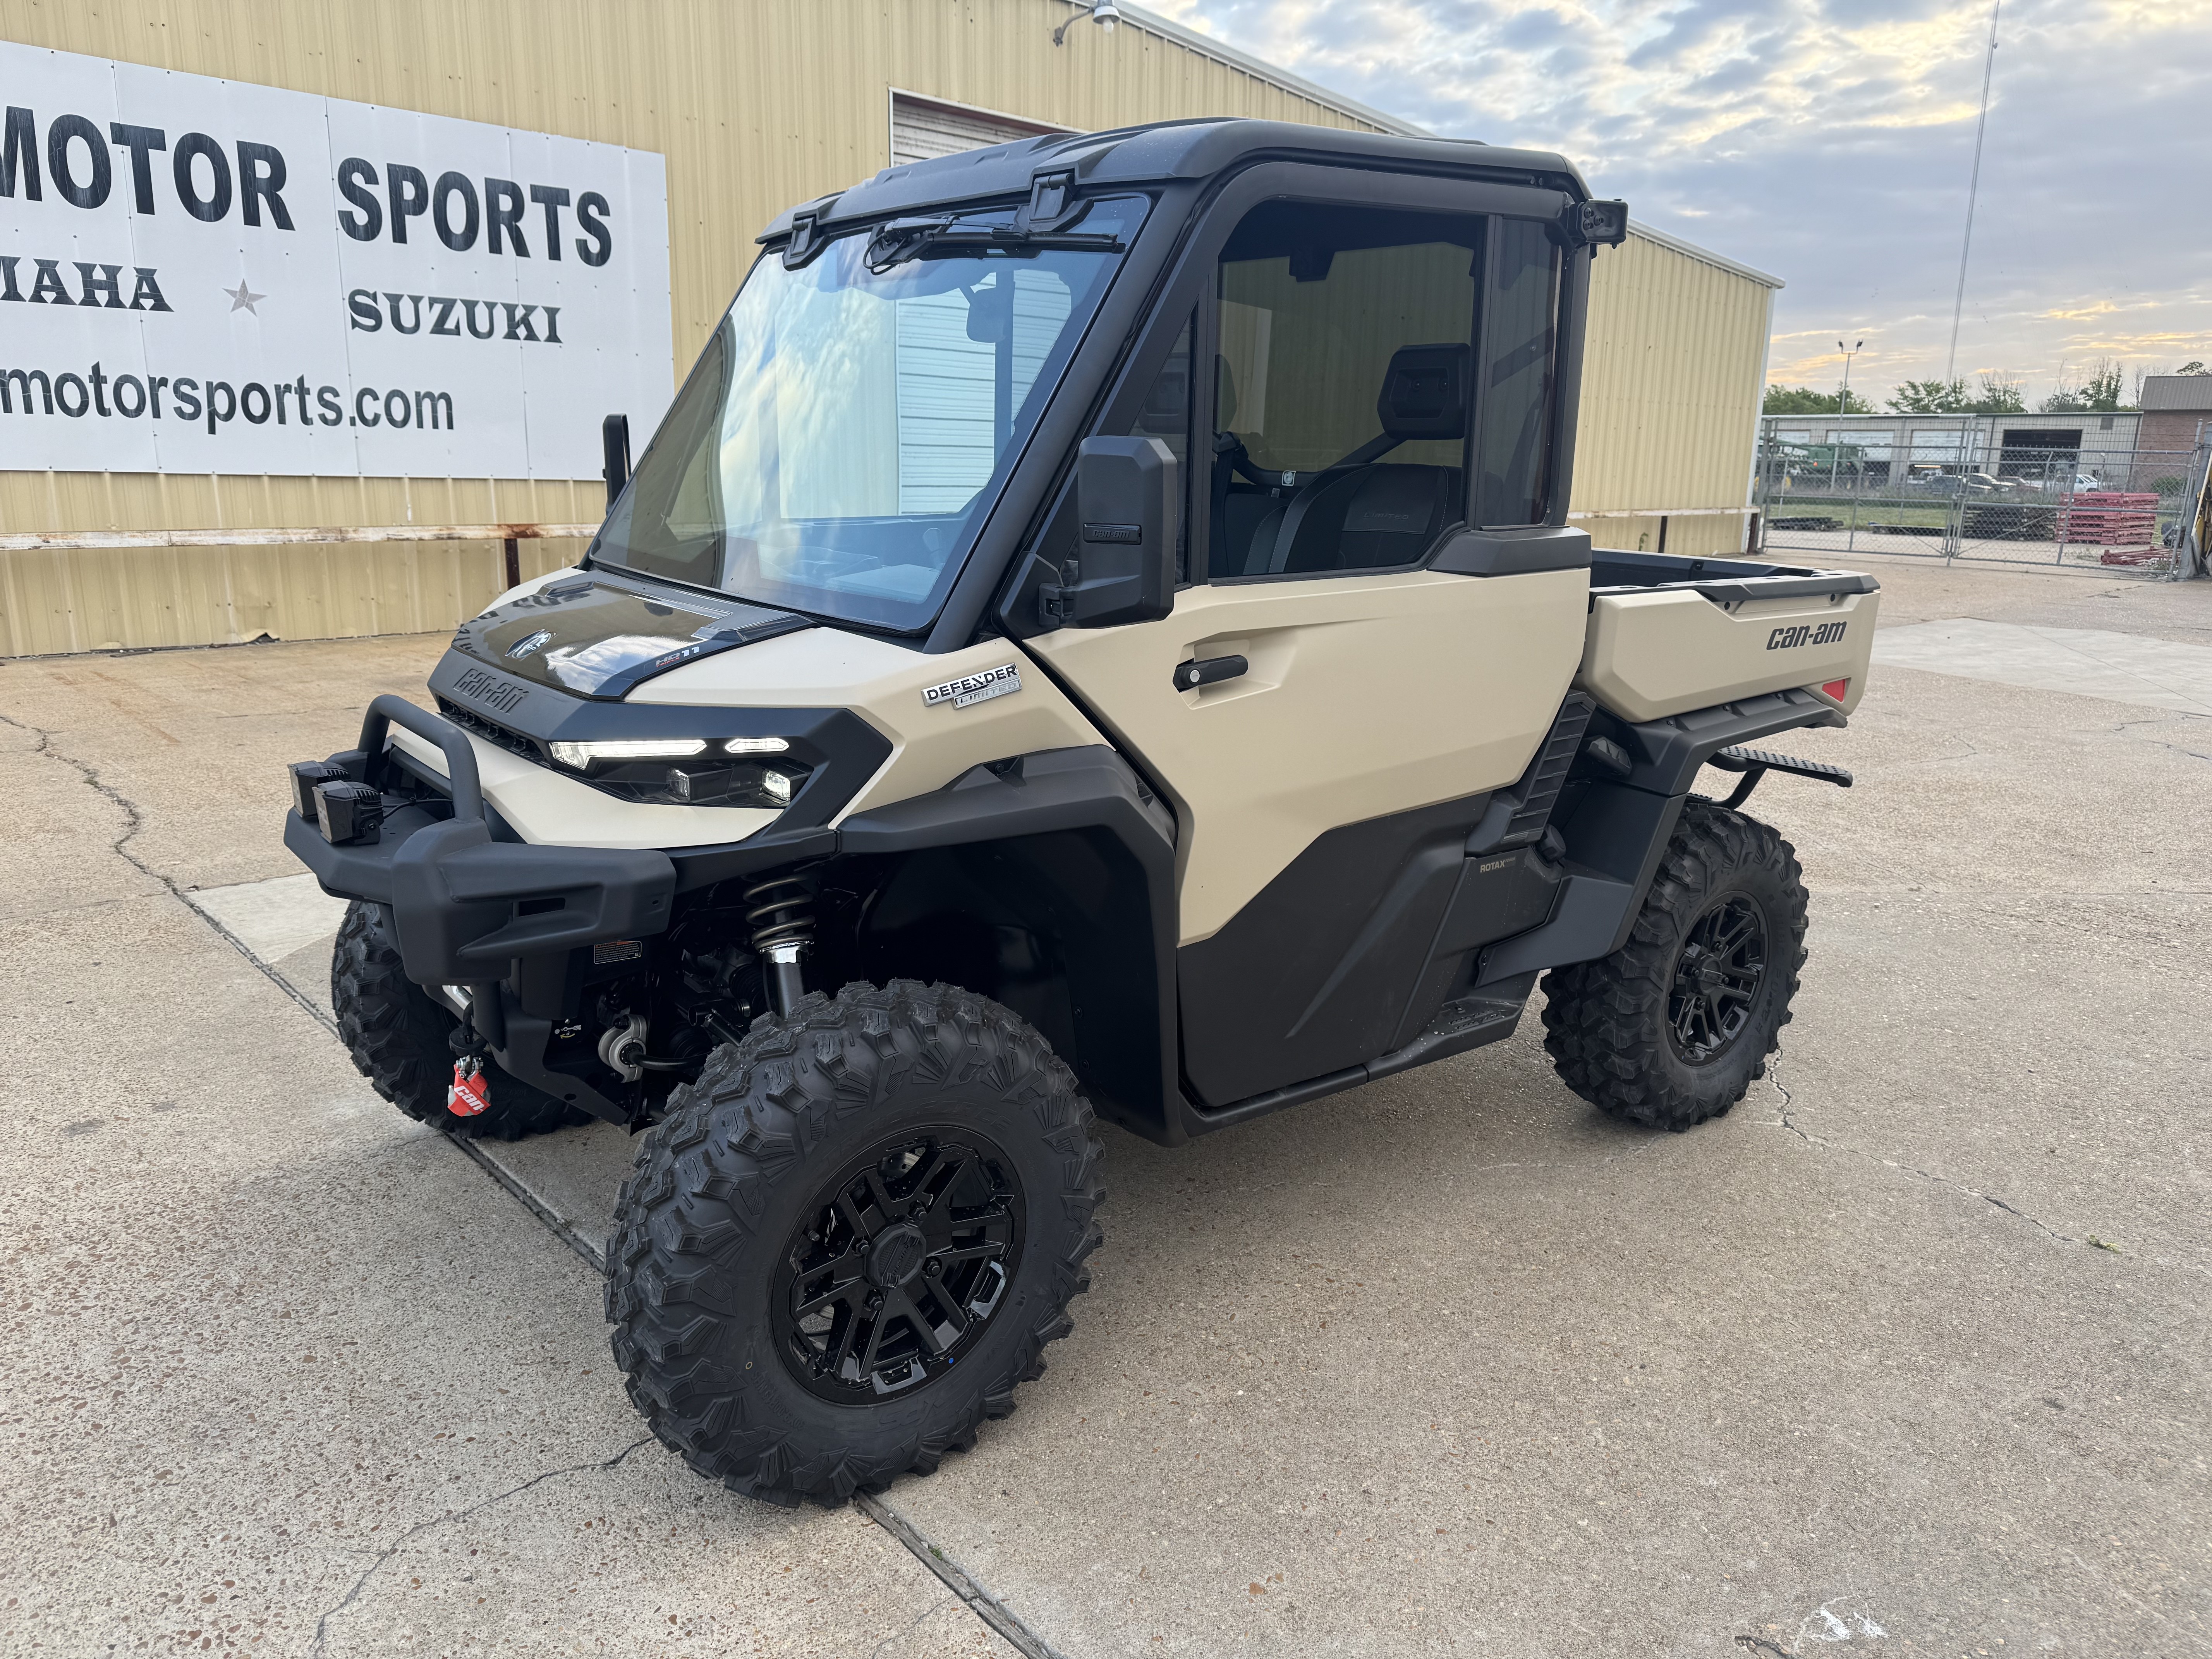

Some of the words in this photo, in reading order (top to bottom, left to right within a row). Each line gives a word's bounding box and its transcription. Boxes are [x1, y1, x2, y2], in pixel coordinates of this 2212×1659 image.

[338, 157, 611, 267] SPORTS
[349, 289, 563, 343] SUZUKI
[1092, 530, 1130, 538] can-am
[1766, 621, 1847, 651] can-am
[453, 668, 529, 715] can-am
[927, 666, 1017, 701] DEFENDER
[960, 682, 1017, 704] LIMITED
[1480, 859, 1505, 873] ROTAX
